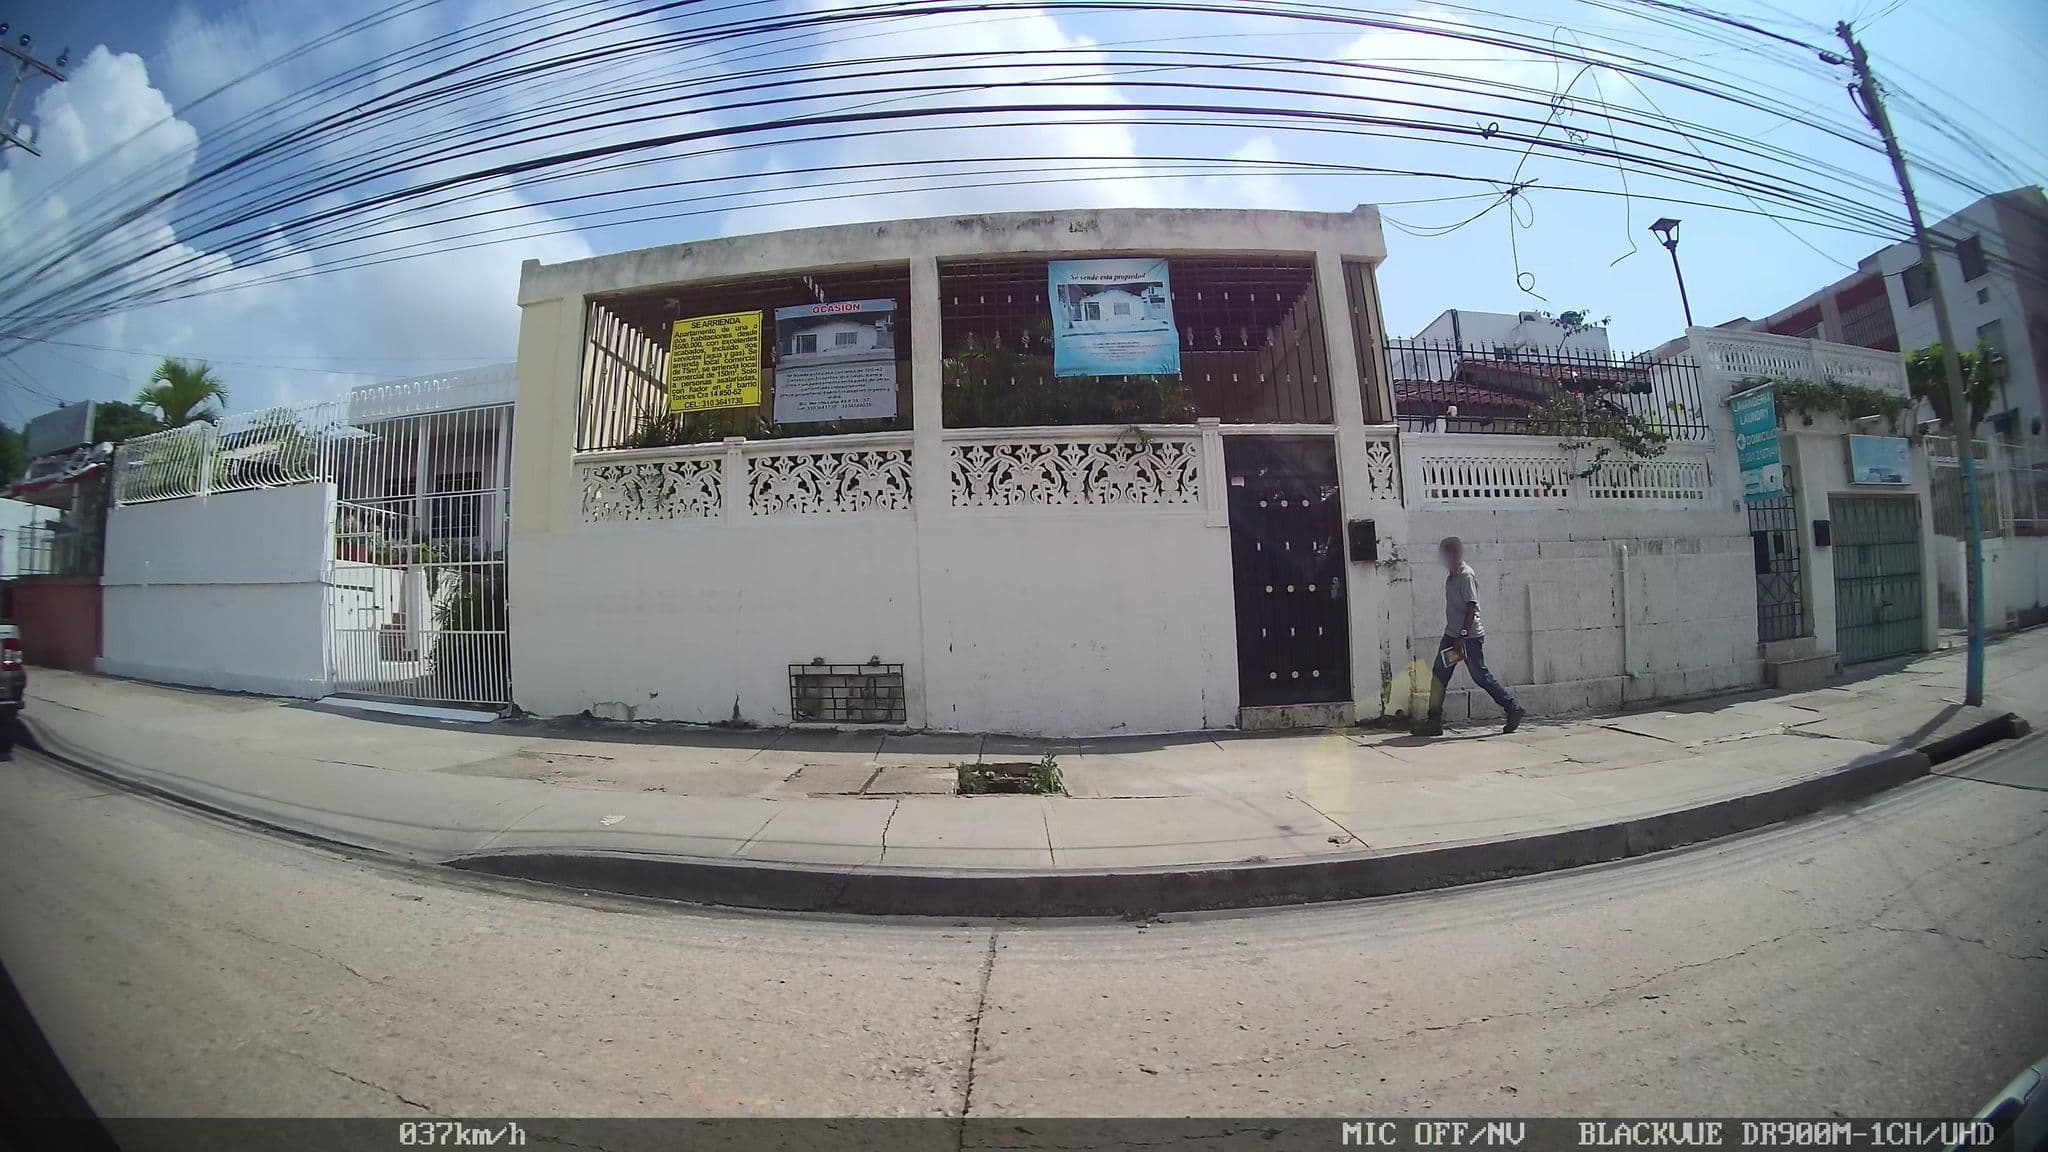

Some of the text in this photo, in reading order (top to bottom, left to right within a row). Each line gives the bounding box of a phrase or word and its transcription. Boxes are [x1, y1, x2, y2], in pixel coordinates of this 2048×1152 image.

[812, 303, 860, 314] OCASION
[702, 317, 741, 327] ARRIENDA
[674, 328, 716, 338] Apartamento
[690, 332, 732, 342] habitaciones
[672, 373, 704, 381] comercial
[681, 380, 712, 388] personas
